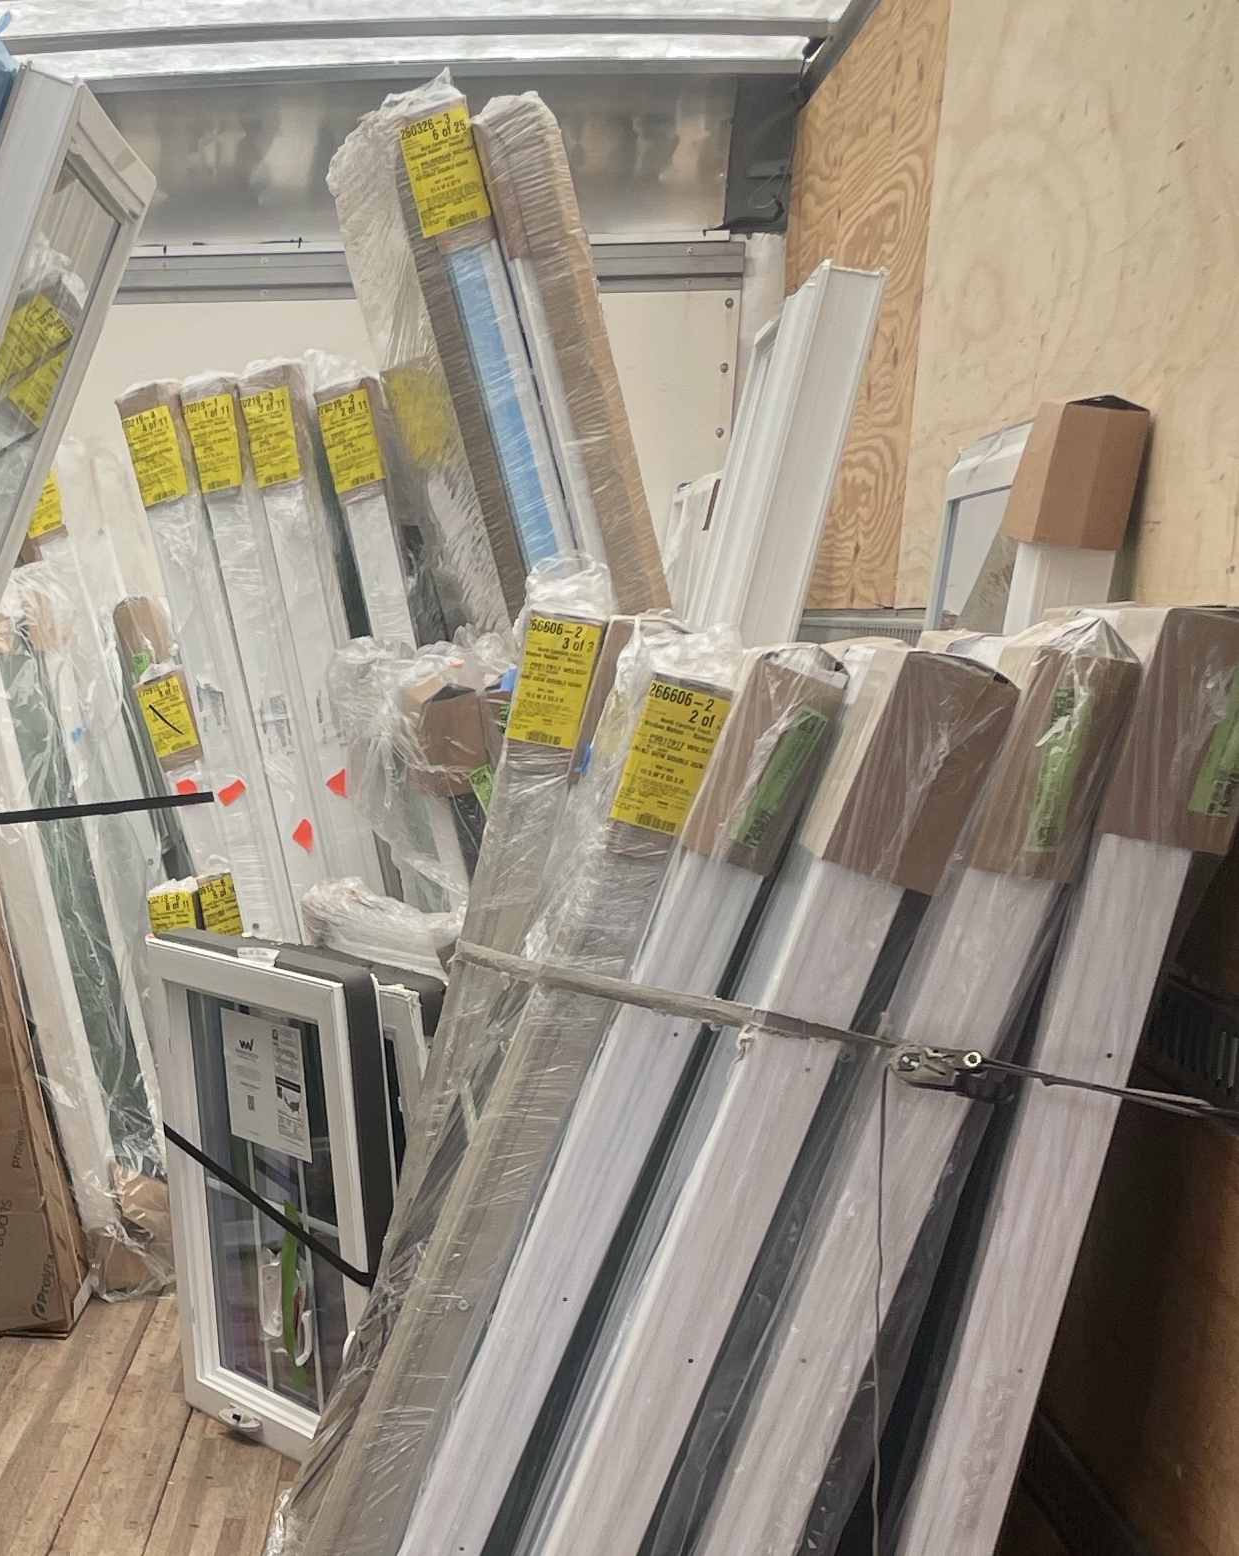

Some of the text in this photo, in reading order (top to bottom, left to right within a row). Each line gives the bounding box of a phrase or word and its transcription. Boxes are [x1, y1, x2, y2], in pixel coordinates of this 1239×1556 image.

[432, 120, 467, 141] 6 of 25
[529, 618, 583, 639] 66606-2
[562, 637, 595, 653] 3 of 3
[650, 682, 715, 712] 266606-2
[688, 710, 699, 724] 2
[701, 714, 717, 728] of
